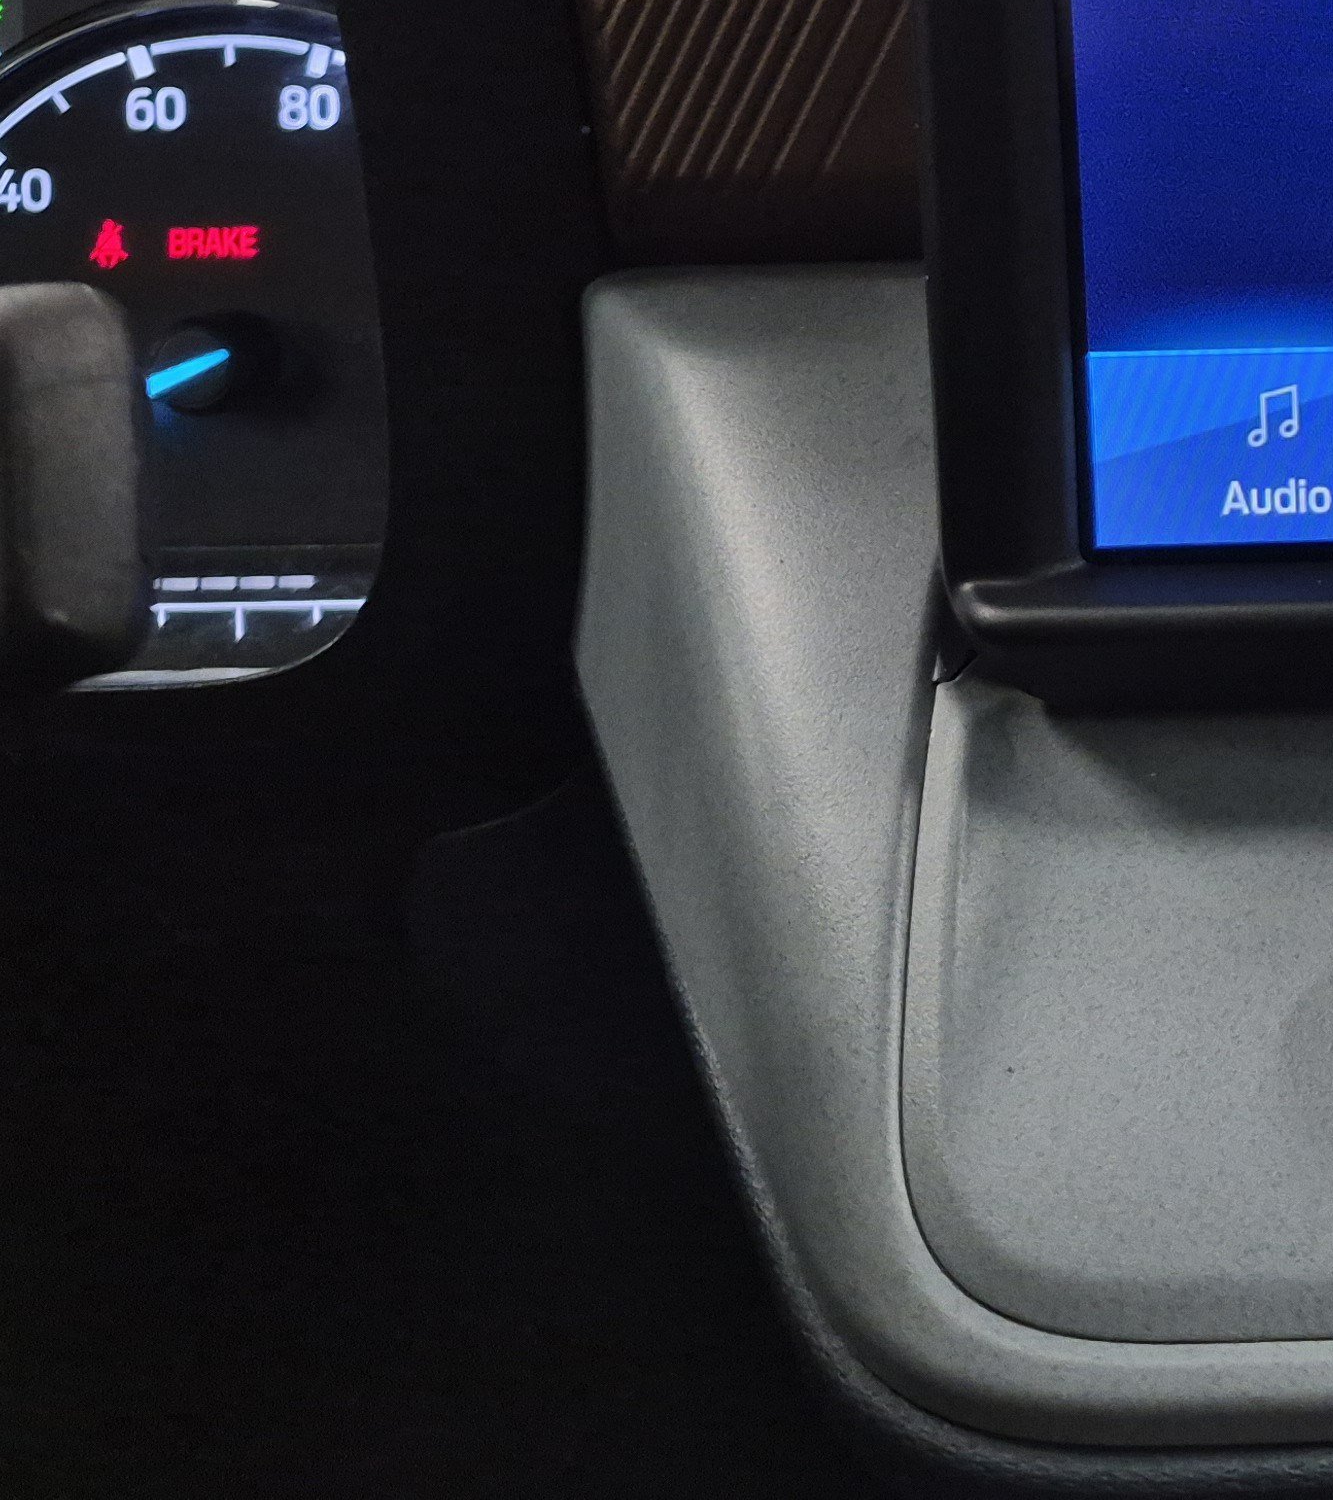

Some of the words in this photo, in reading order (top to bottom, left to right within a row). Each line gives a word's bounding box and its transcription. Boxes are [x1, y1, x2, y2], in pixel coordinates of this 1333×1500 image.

[125, 86, 187, 132] 60
[278, 84, 341, 131] 80
[0, 167, 52, 213] 40
[168, 225, 260, 260] BRAKE
[1222, 477, 1332, 516] Audio
